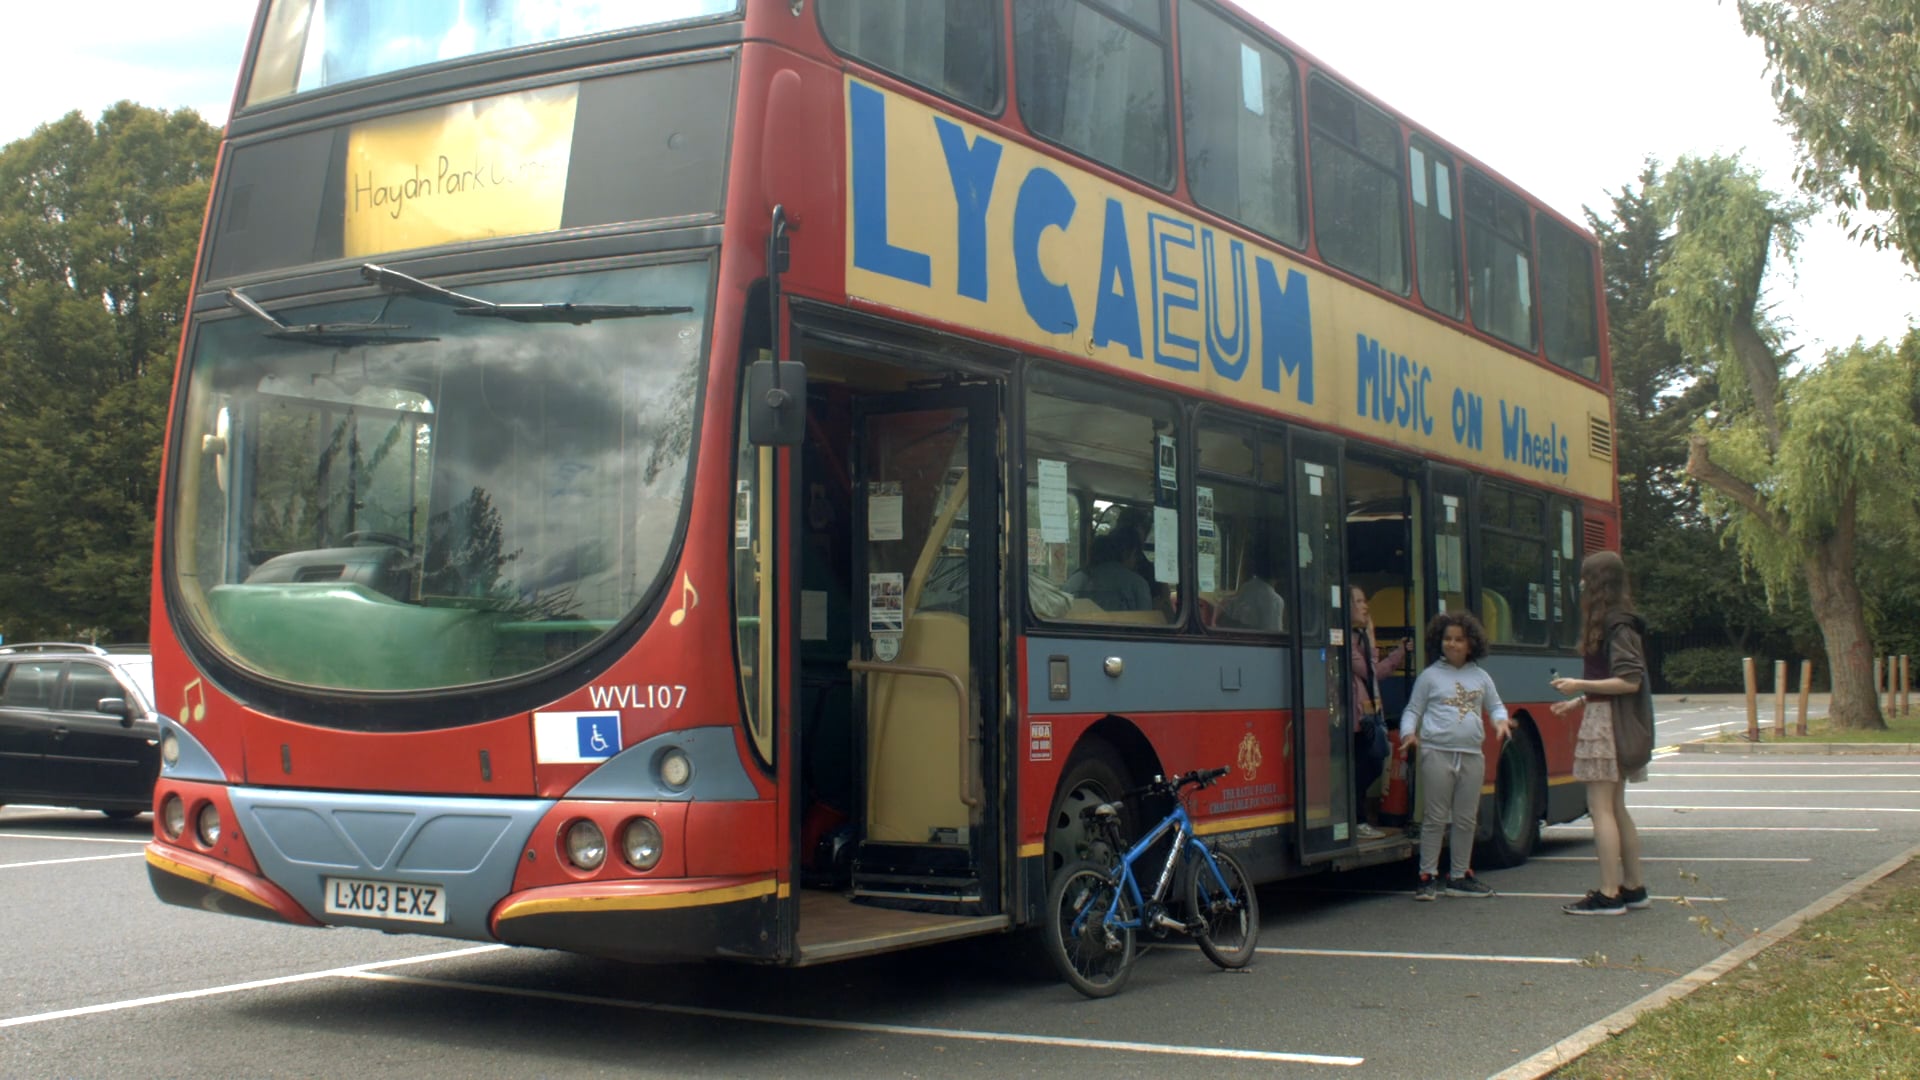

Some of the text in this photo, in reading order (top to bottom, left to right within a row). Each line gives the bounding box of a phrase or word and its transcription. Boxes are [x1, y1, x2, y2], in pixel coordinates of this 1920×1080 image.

[354, 164, 432, 219] Haydn
[437, 153, 484, 195] Park
[849, 79, 1314, 405] LYCAEUM
[588, 685, 688, 710] WVL107
[334, 880, 437, 917] LX03 EXZ
